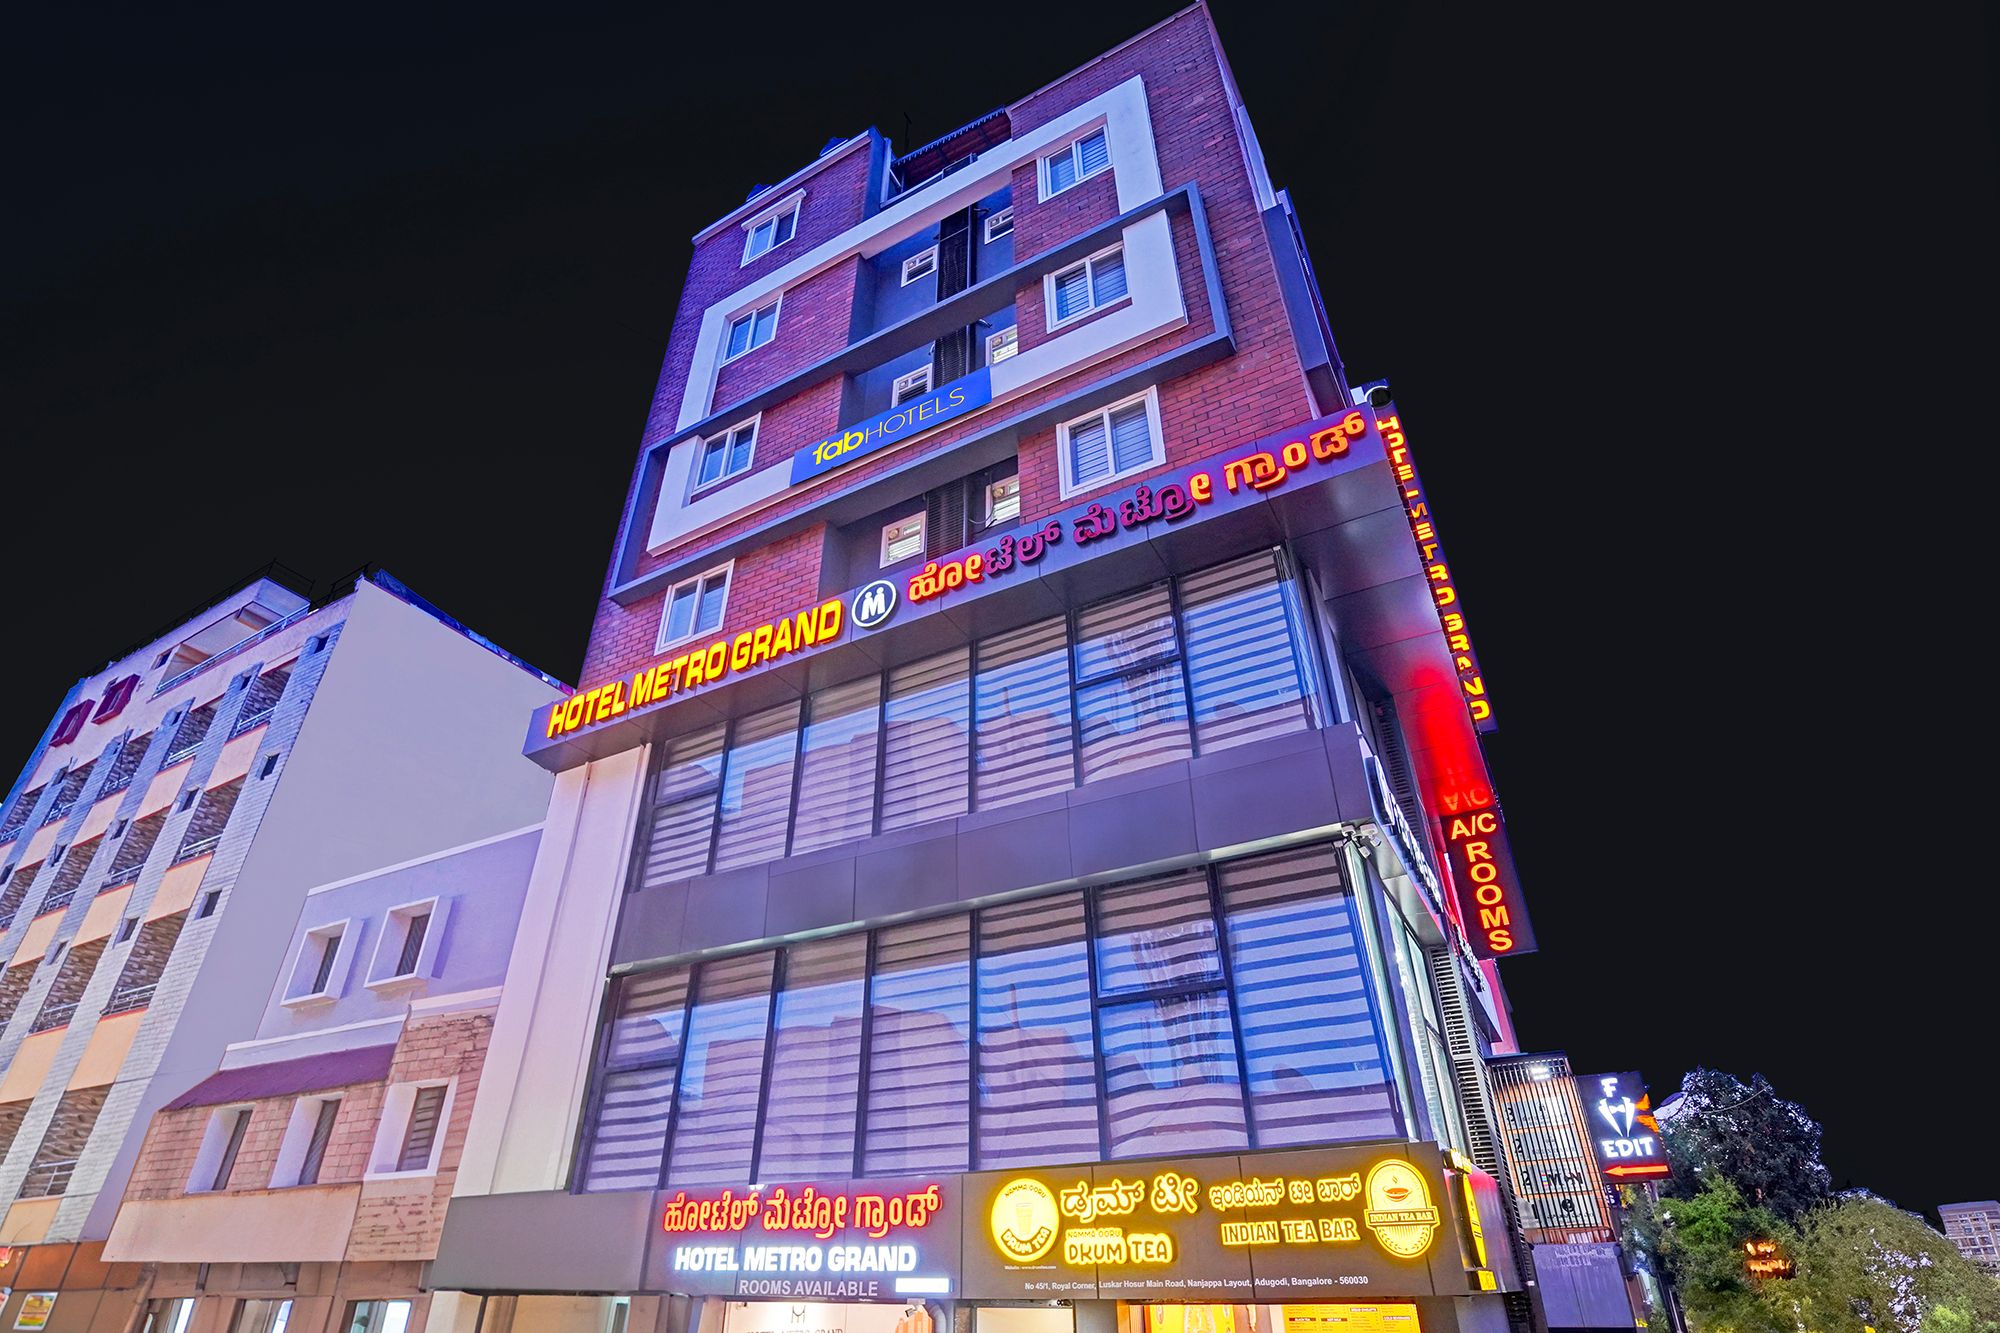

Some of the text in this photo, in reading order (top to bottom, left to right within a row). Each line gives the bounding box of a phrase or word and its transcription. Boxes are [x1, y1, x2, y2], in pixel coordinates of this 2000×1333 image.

[813, 388, 965, 465] fabHOTELS
[907, 520, 1061, 603] ಹೋಟೆಲ್
[547, 599, 844, 738] HOTEL METRO GRAND
[1451, 812, 1497, 841] A/C
[1465, 840, 1513, 952] ROOMS
[1601, 1136, 1654, 1159] EDIT
[664, 1190, 761, 1232] ಹೋಟೆಲ್
[854, 1184, 942, 1237] ಗ್ರಾಂಡ್
[1370, 1210, 1434, 1224] INDIAN TEA BAR
[1222, 1219, 1359, 1244] INDIAN TEA BAR
[674, 1245, 917, 1272] HOTEL METRO GRAND
[1130, 1239, 1169, 1261] TEA
[739, 1279, 879, 1297] ROOMS AVAILABLE
[1025, 1282, 1034, 1290] No
[1052, 1282, 1071, 1291] Royal
[1072, 1281, 1097, 1290] Corner,
[1099, 1281, 1122, 1289] Luskar
[1123, 1280, 1145, 1288] Hosur
[1146, 1280, 1164, 1288] Main
[1164, 1279, 1186, 1288] Road,
[1187, 1279, 1222, 1288] Nanjappa
[1223, 1278, 1253, 1288] Layout,
[1254, 1277, 1290, 1288] Adugodi,
[1291, 1276, 1332, 1287] Bangalore
[1339, 1275, 1369, 1285] 560030
